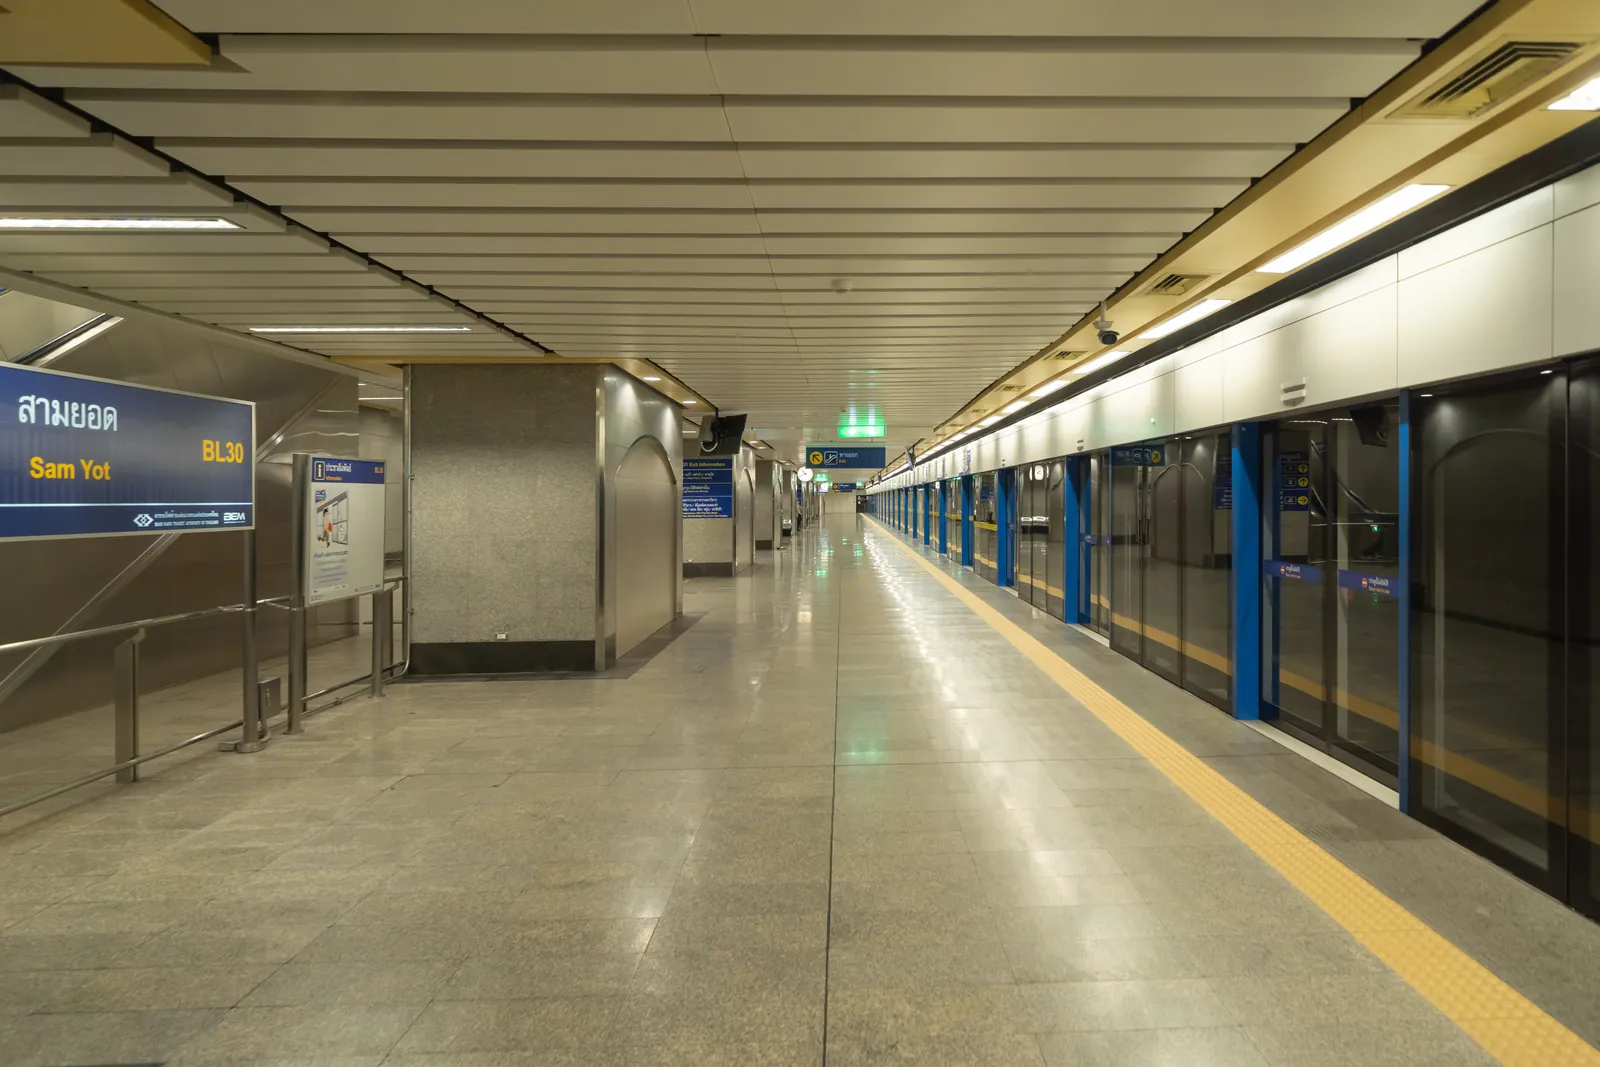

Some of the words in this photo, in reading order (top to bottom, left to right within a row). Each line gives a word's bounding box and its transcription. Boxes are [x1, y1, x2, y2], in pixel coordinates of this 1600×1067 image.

[18, 394, 118, 431] สามยอด
[202, 439, 244, 464] BL30
[29, 456, 75, 480] Sam
[80, 458, 111, 481] Yot
